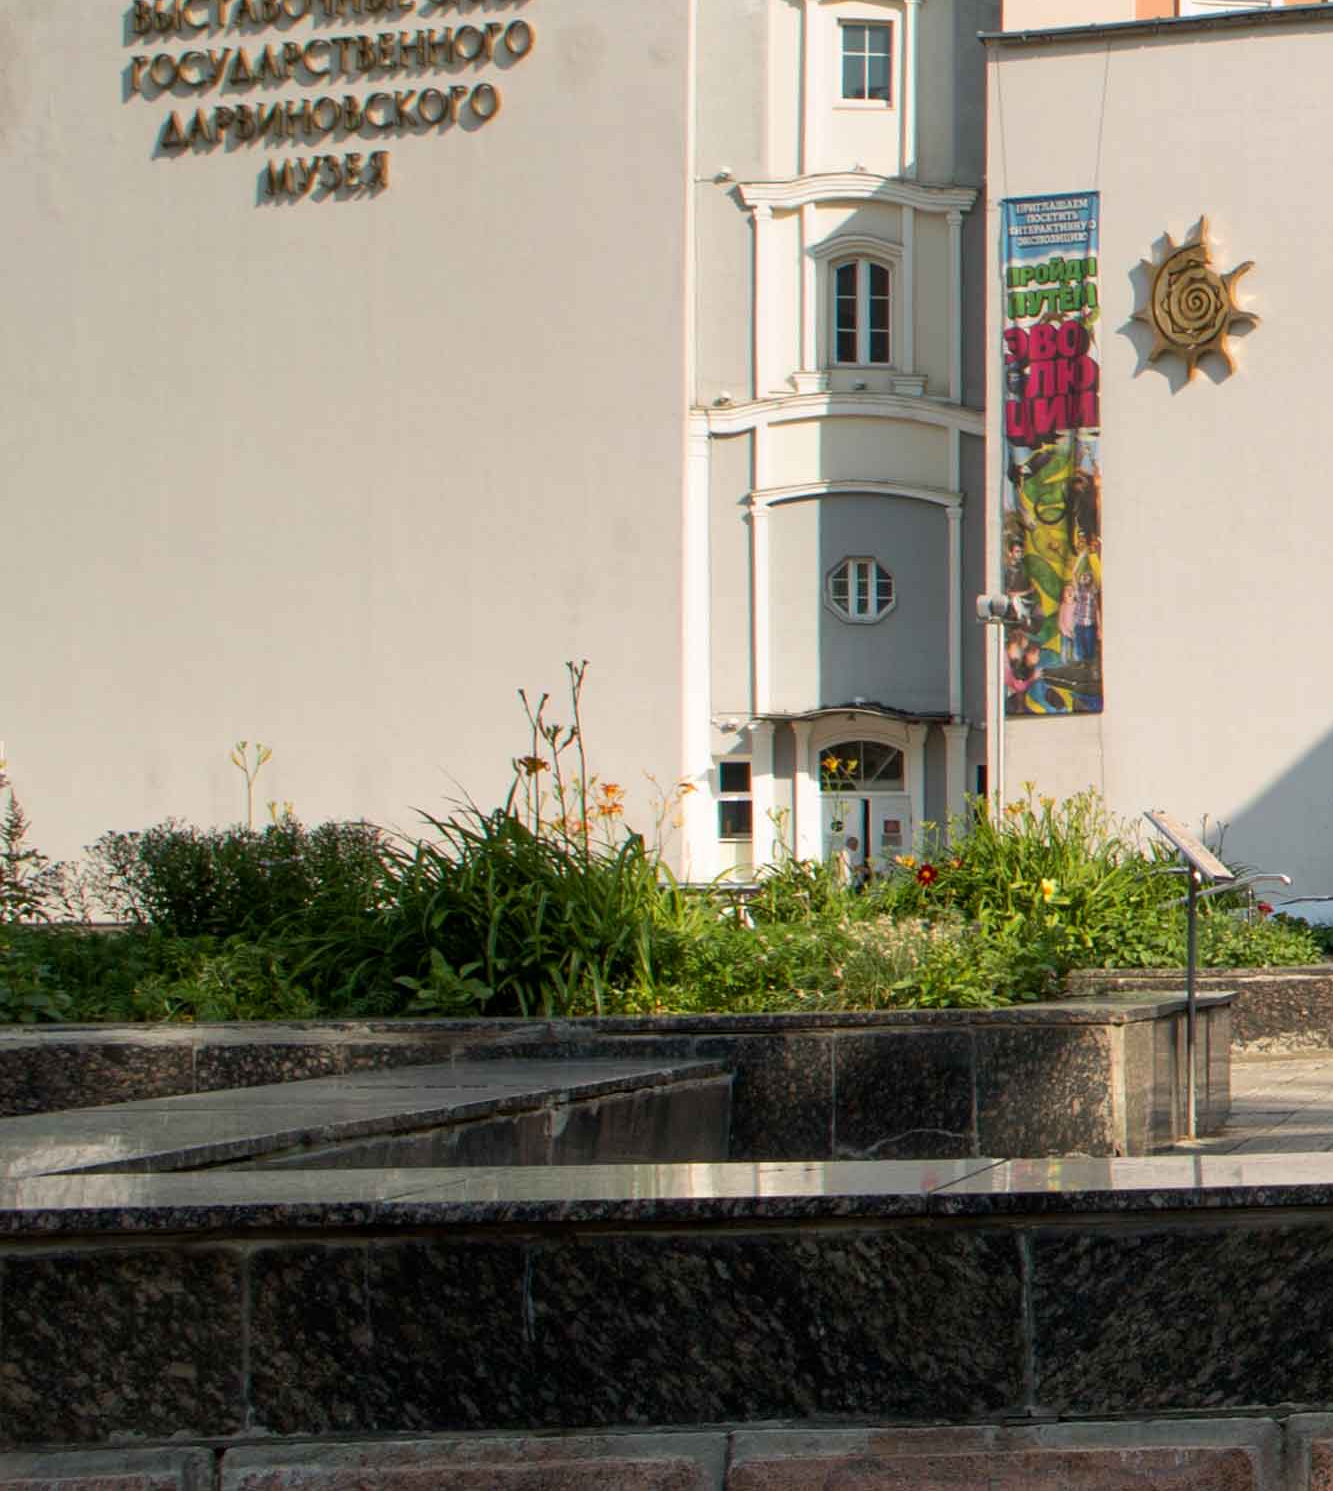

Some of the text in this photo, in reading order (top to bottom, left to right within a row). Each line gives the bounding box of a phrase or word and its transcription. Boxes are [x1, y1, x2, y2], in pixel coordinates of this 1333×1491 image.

[130, 19, 536, 92] ГОСУДАРСТВЕННОГО
[161, 82, 502, 149] ДАРВИНОВСКОГО
[264, 150, 391, 198] МУЗЕЯ
[1004, 320, 1087, 365] ЭВО
[1024, 354, 1096, 399] ЛЮ
